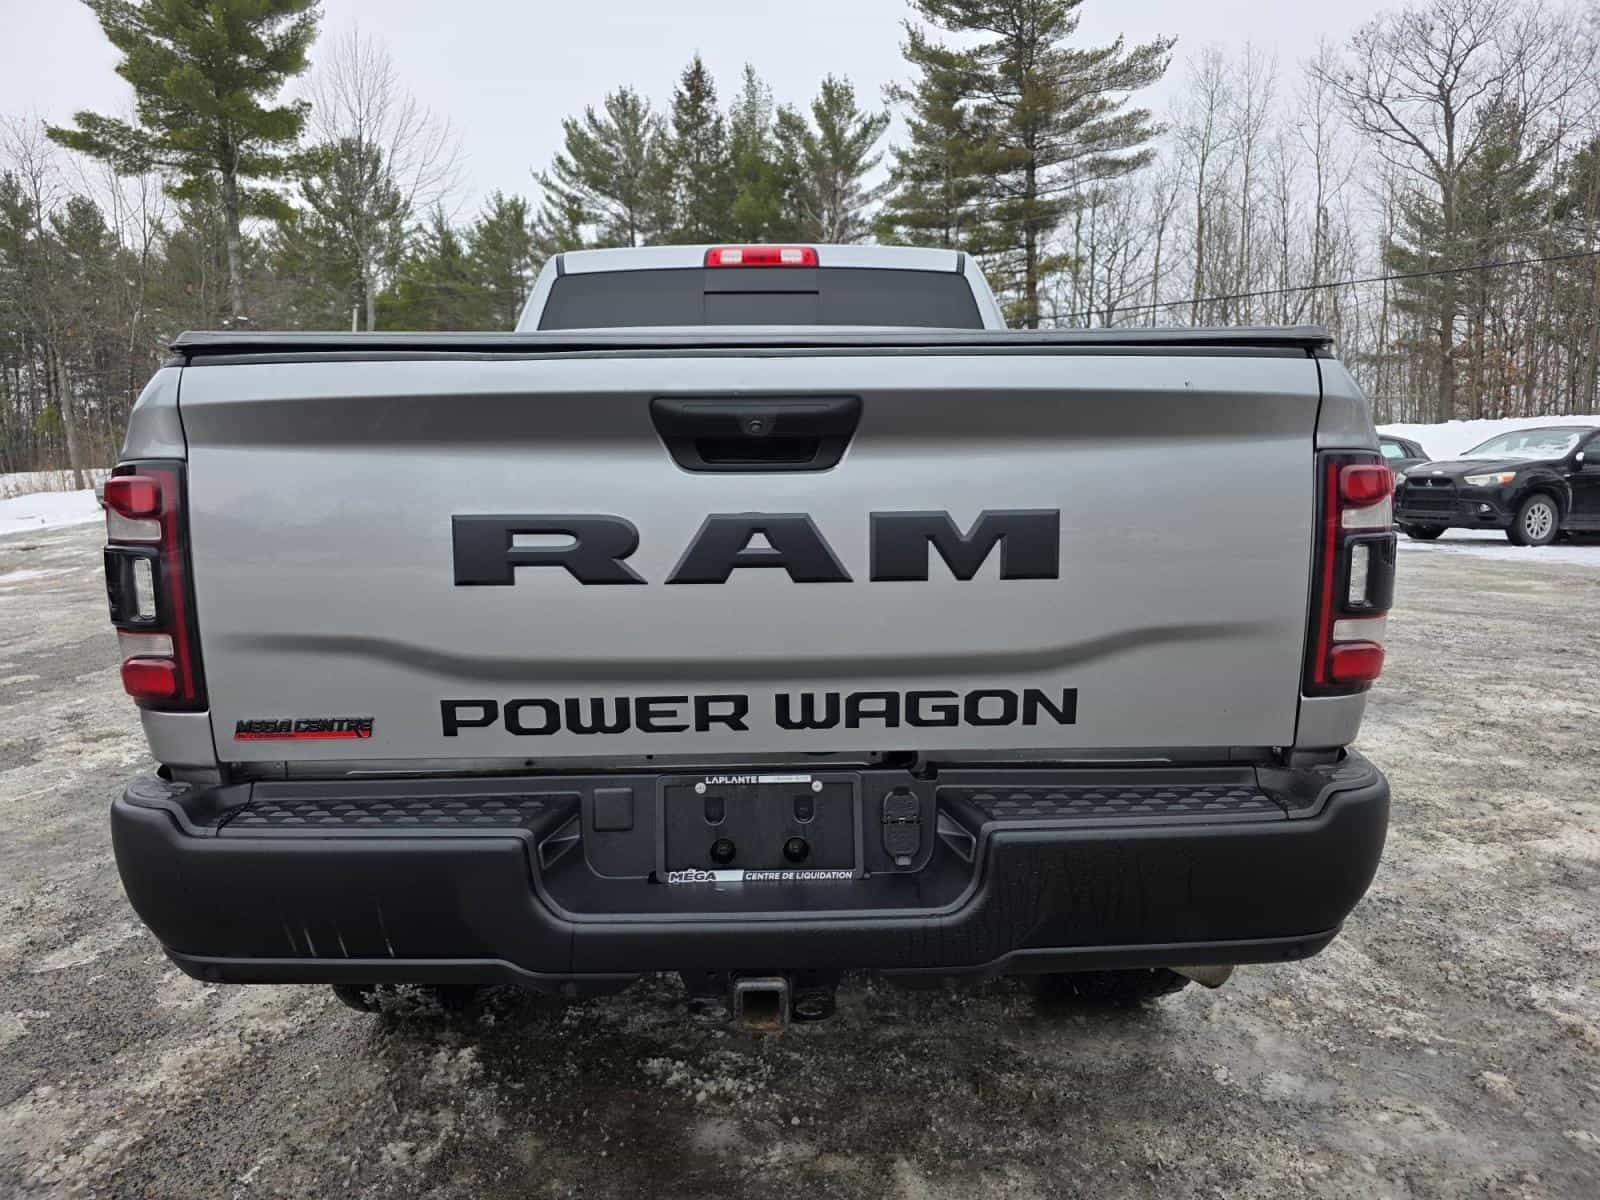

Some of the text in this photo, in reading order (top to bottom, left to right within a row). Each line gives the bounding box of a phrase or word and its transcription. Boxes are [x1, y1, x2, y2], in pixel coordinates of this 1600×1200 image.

[452, 508, 1061, 586] RAM
[440, 688, 1078, 736] POWER WAGON
[294, 716, 374, 738] CENTRE
[705, 776, 757, 784] LAPLANTE
[668, 868, 853, 883] MÉGA CENTRE DE LIQUIDATION
